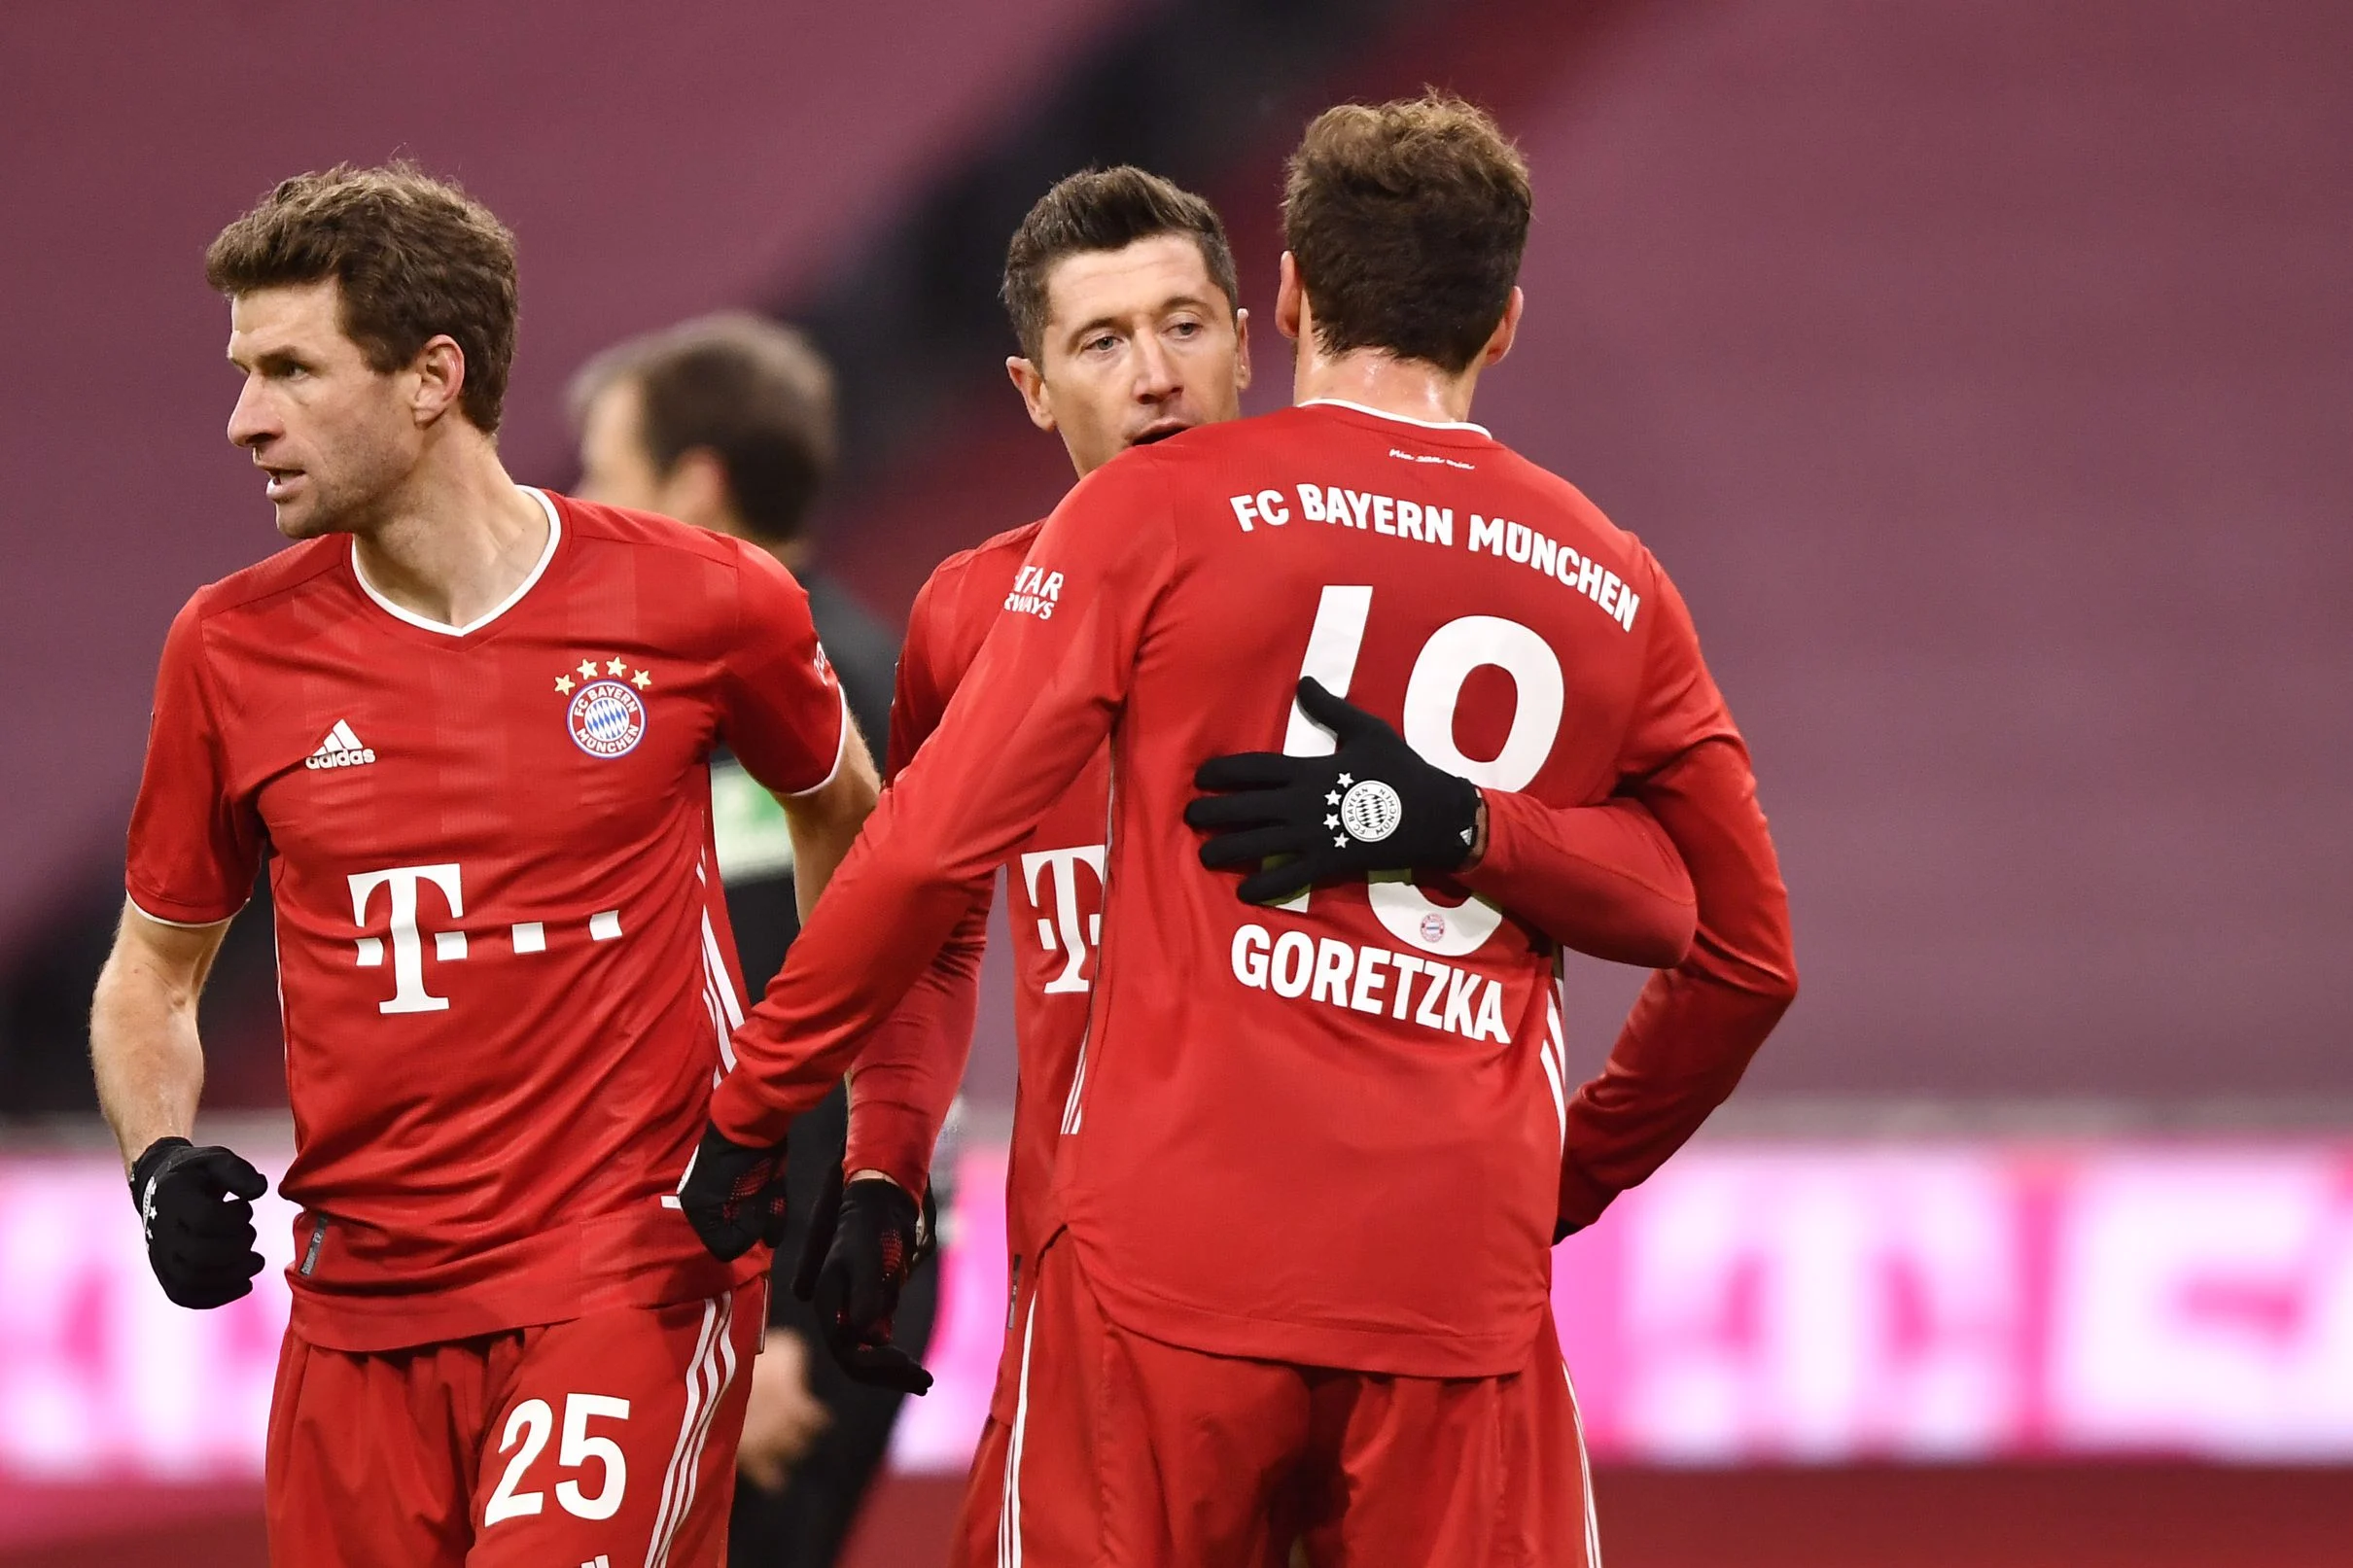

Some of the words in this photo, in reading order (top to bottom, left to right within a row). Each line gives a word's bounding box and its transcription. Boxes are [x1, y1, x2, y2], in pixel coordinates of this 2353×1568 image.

[1229, 489, 1290, 533] FC
[1295, 483, 1455, 547] BAYERN
[1467, 513, 1641, 633] MÜNCHEN
[304, 748, 377, 770] adidas
[574, 698, 590, 717] FC
[586, 685, 638, 714] BAYERN
[1230, 923, 1512, 1045] GORETZKA
[484, 1393, 630, 1527] 25
